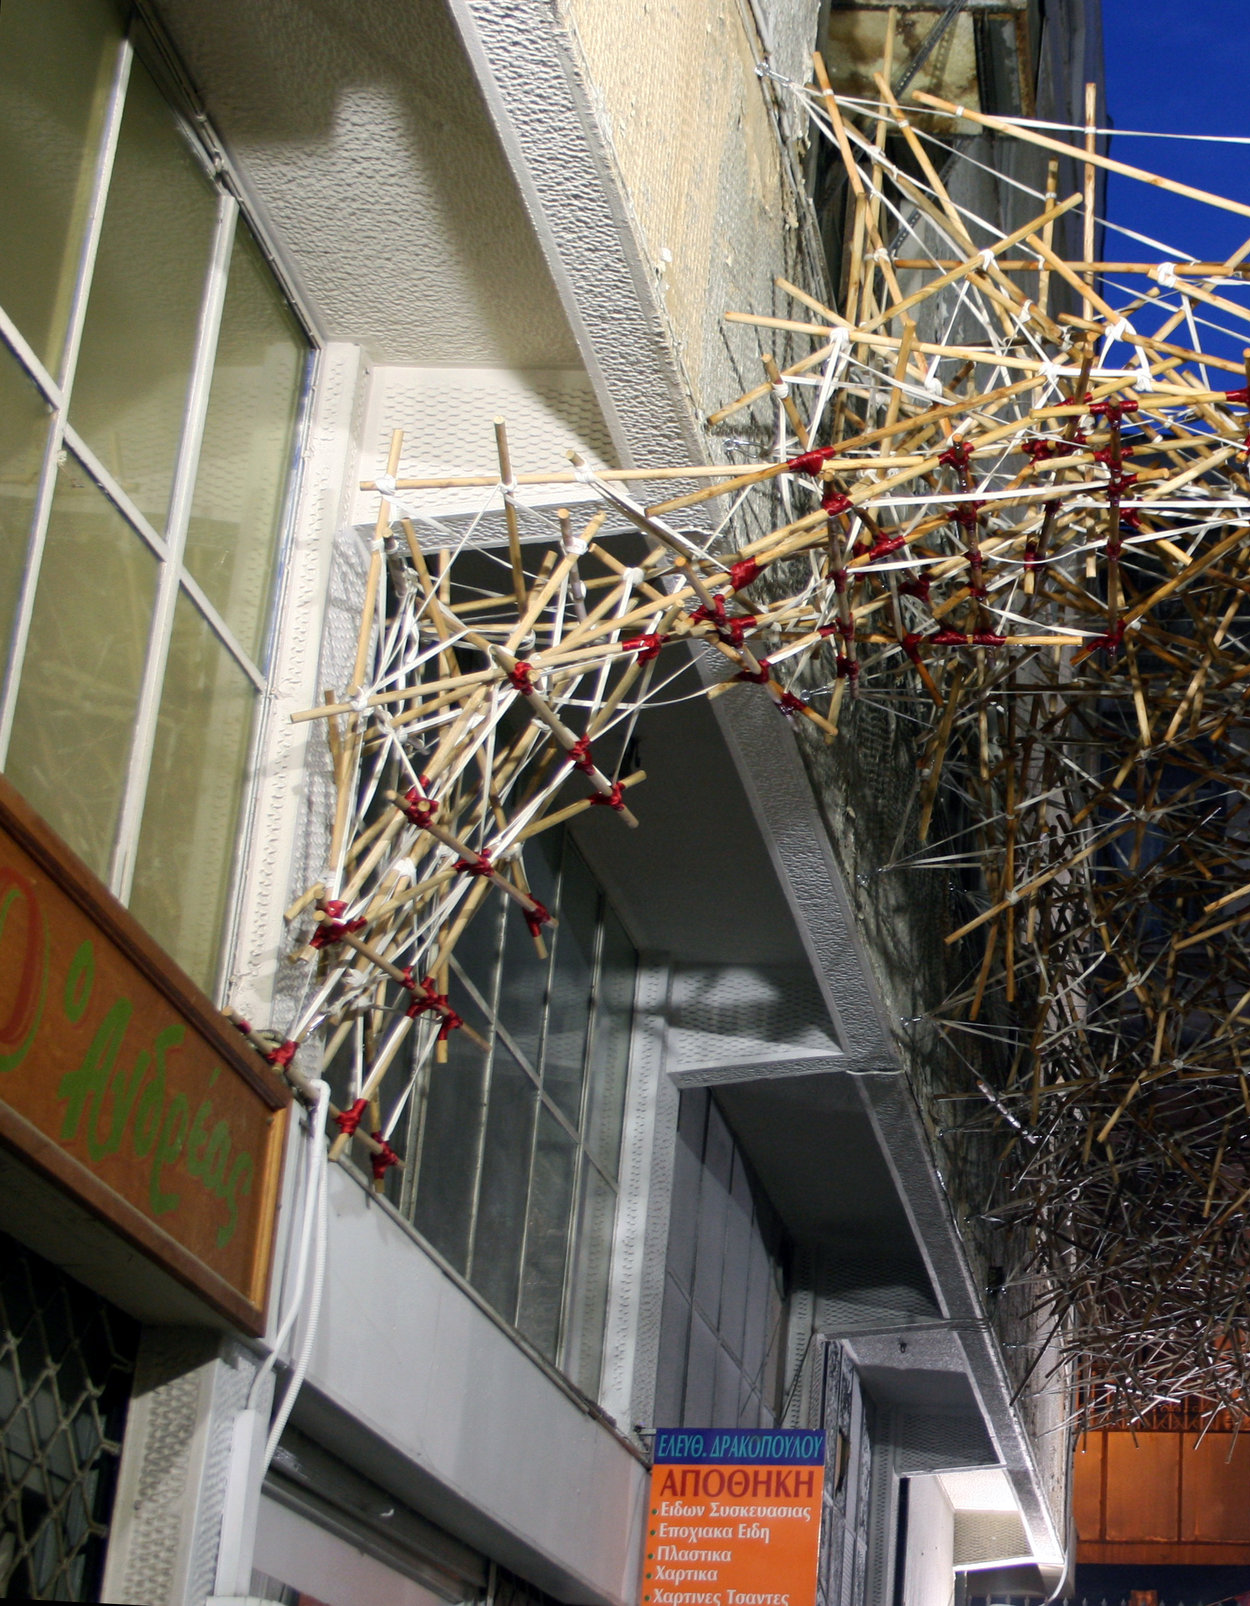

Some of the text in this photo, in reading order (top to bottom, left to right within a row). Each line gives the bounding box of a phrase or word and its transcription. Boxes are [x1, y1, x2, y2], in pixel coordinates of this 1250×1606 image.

[658, 1435, 823, 1458] ΕΛΕΥΘ. ΔΡΑΚΟΠΟΥΛΟΥ
[660, 1468, 814, 1498] ΑΠΟΘΗΚΗ
[660, 1500, 811, 1521] Ειδων Συσκευασιας
[659, 1522, 770, 1544] Εποχιακα Ειδη
[656, 1545, 732, 1562] Πλαστικα
[655, 1565, 718, 1586] Χαρτικα
[653, 1588, 790, 1605] Χαρτινες Τσαντες
